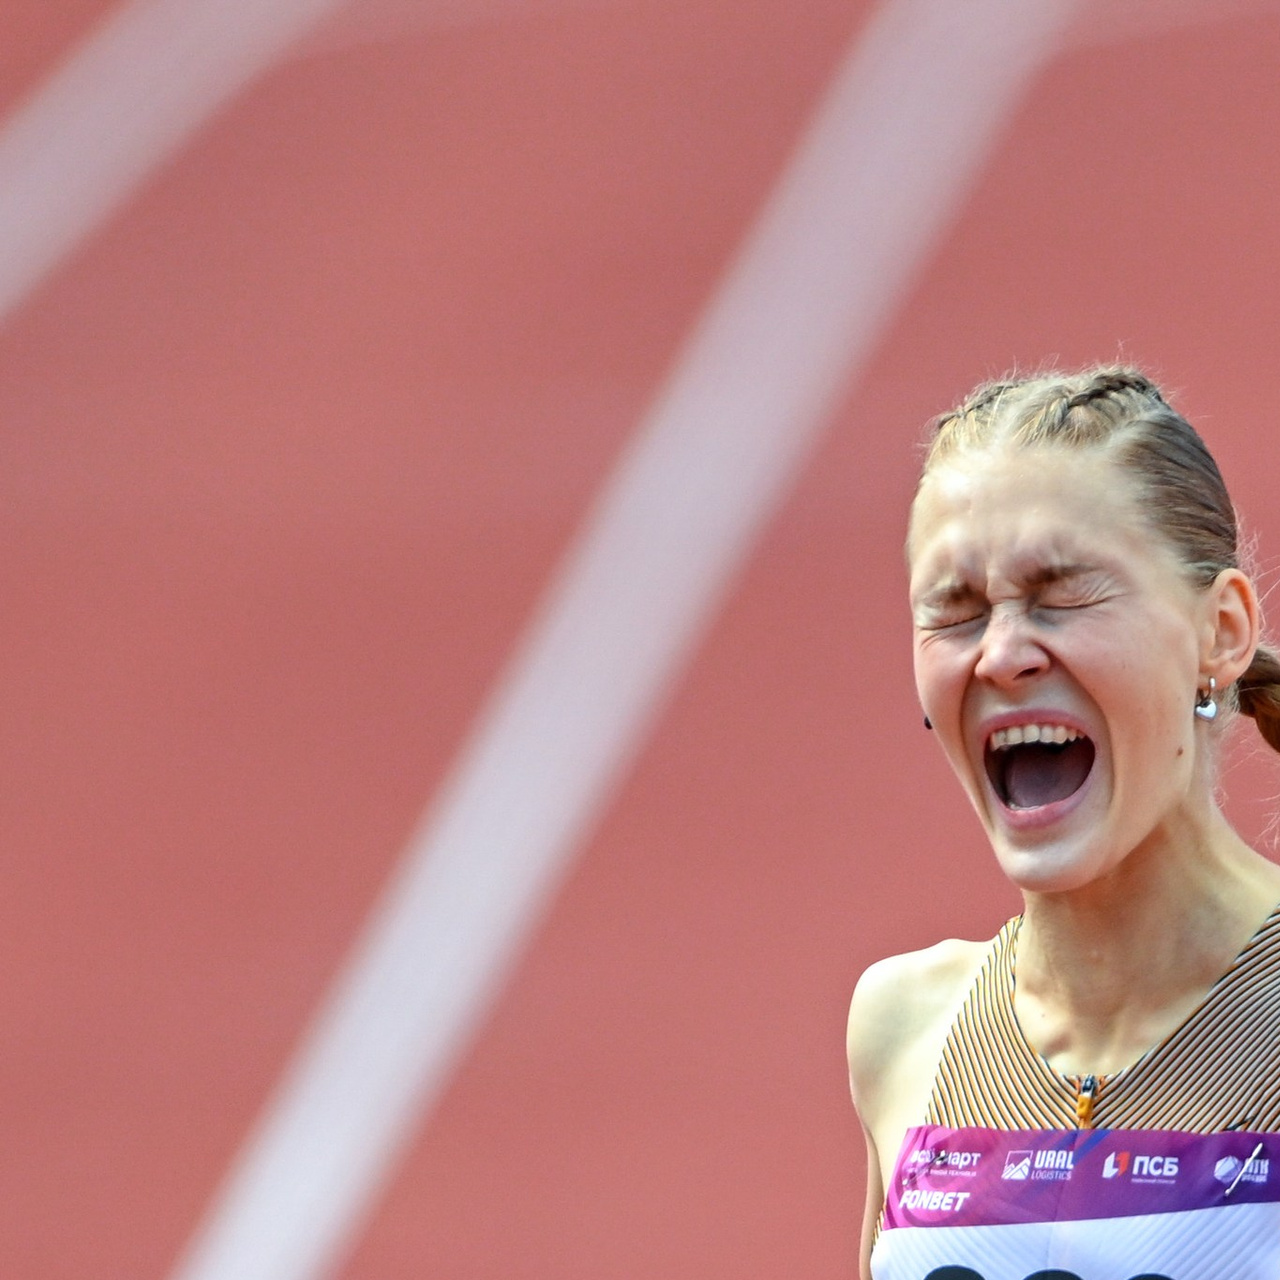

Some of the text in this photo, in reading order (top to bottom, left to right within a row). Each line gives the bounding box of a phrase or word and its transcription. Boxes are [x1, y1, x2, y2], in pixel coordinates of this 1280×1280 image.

[1034, 1150, 1074, 1169] URAL
[1132, 1155, 1179, 1177] ПСБ
[1031, 1169, 1072, 1181] LOGISTICS
[898, 1190, 971, 1212] FONBET
